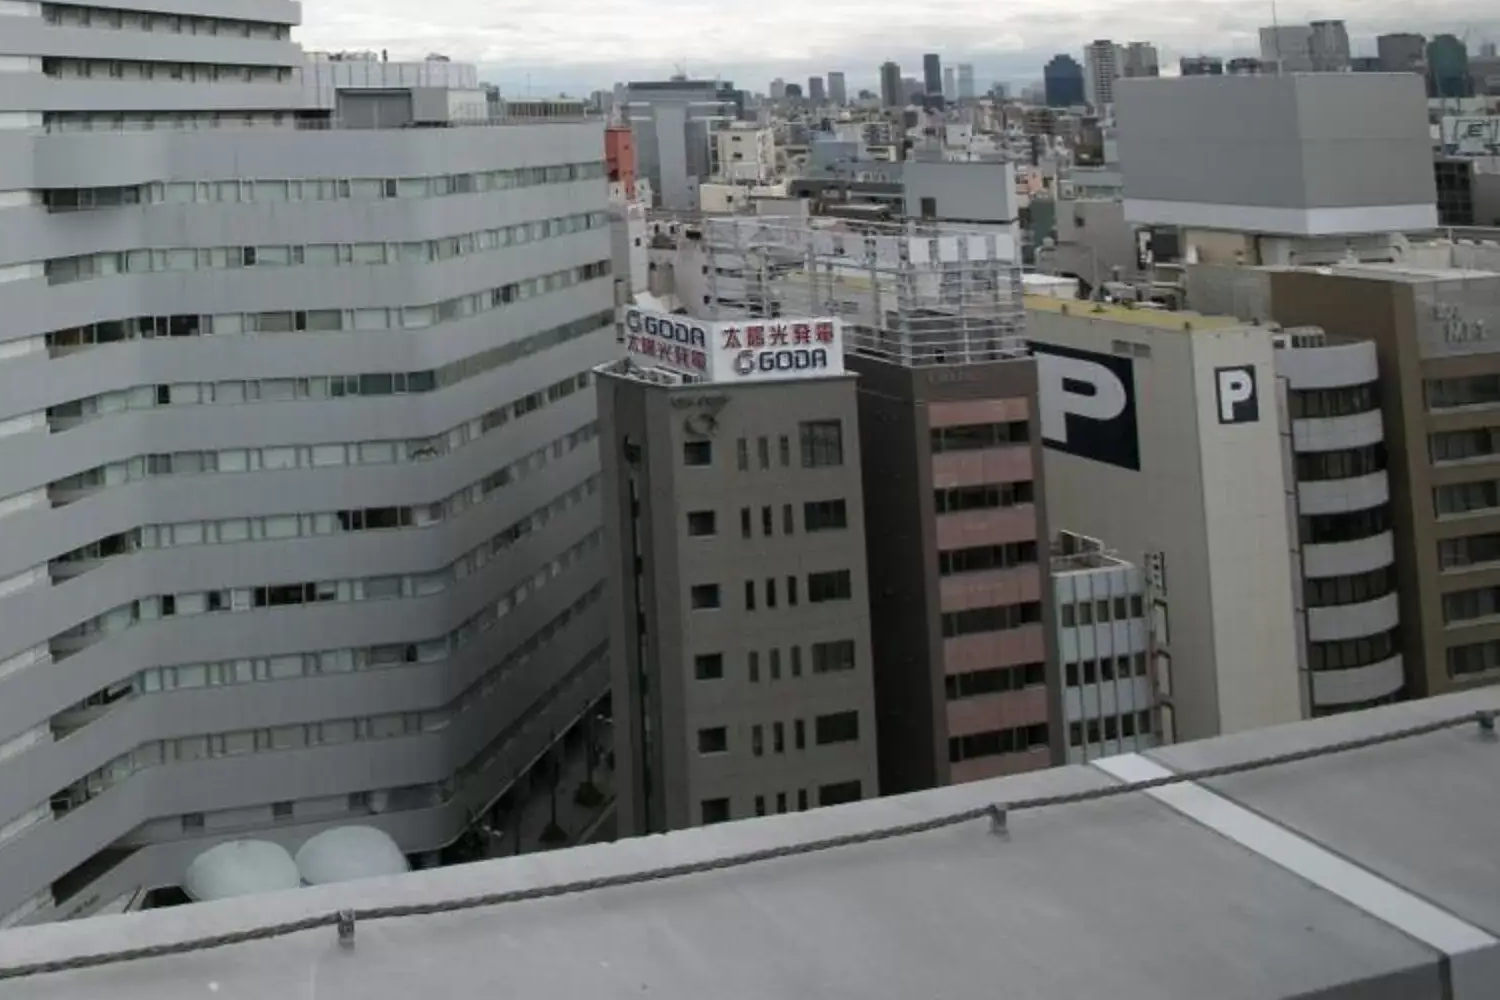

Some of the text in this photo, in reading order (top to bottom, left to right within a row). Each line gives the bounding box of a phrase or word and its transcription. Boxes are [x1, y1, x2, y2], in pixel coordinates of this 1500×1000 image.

[645, 315, 705, 347] GODA
[759, 348, 827, 371] GODA
[1036, 352, 1127, 444] P
[1219, 369, 1253, 420] P
